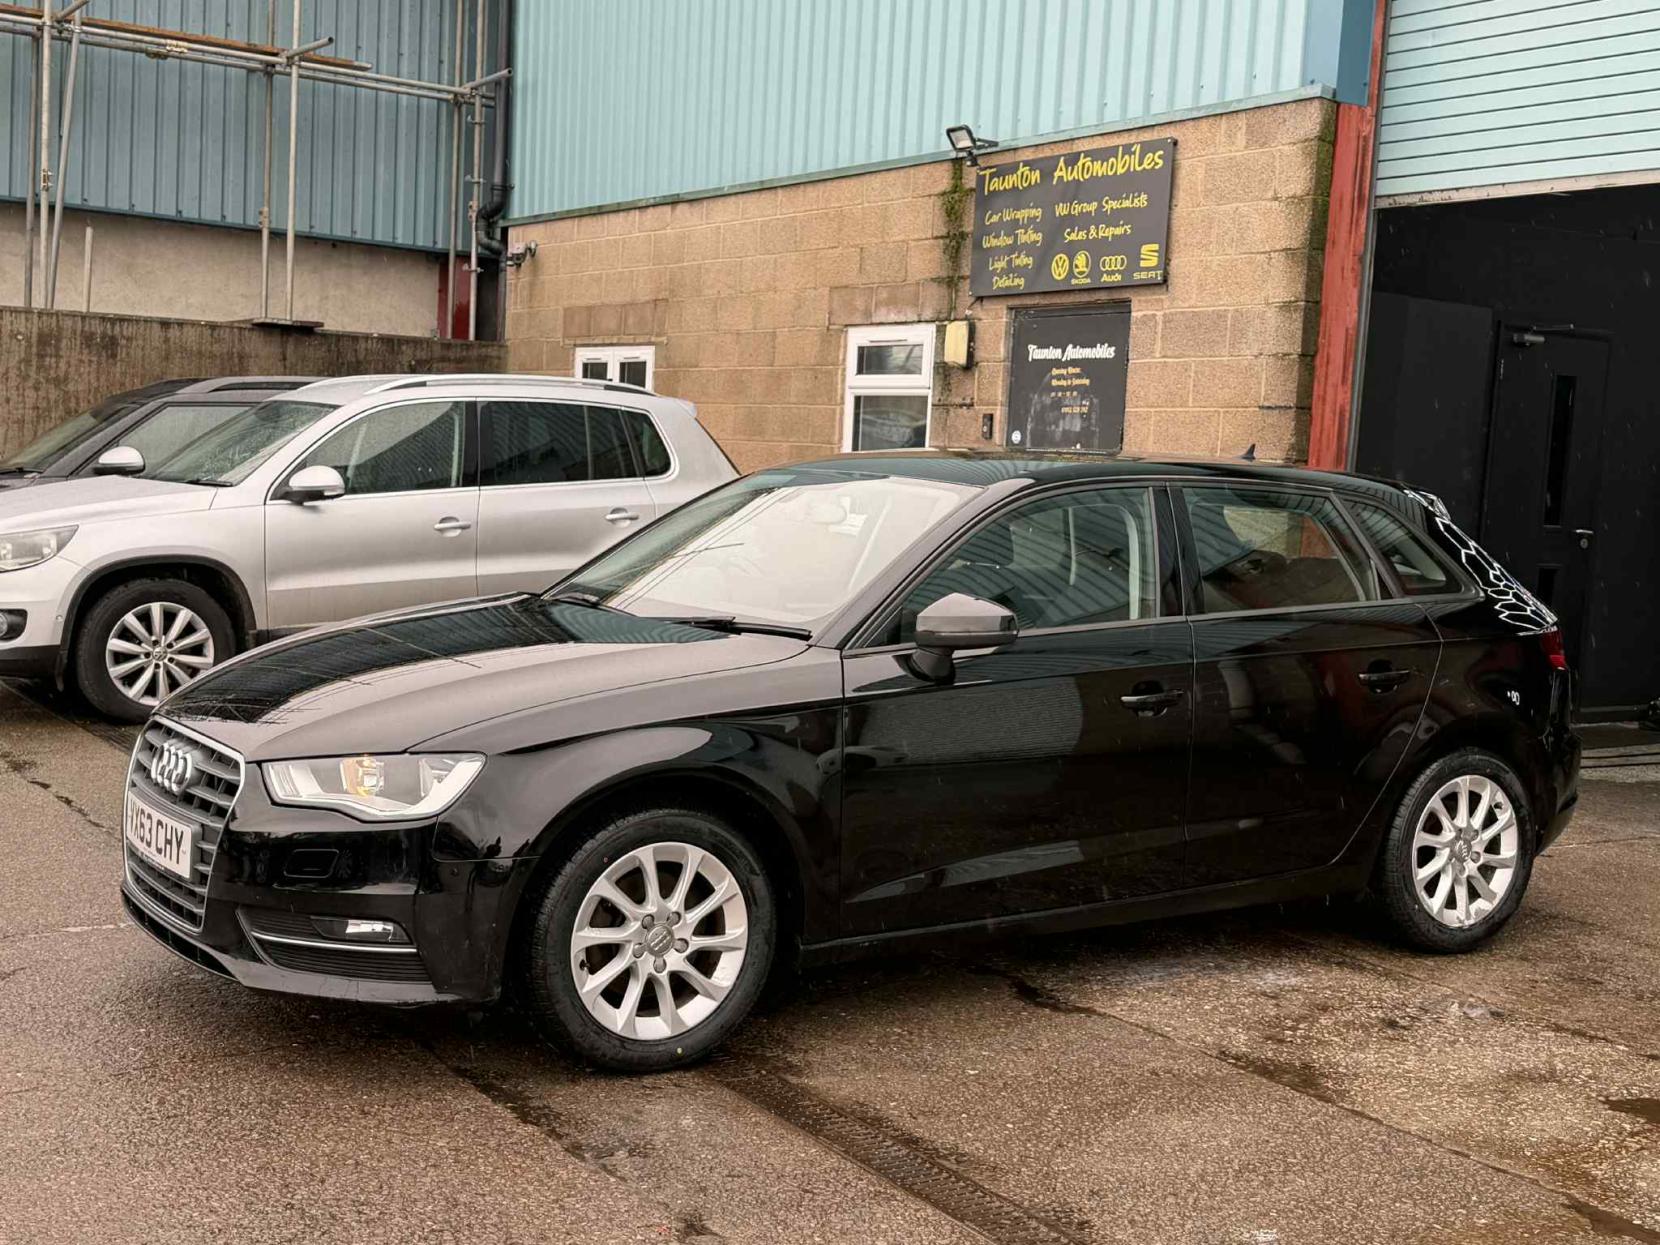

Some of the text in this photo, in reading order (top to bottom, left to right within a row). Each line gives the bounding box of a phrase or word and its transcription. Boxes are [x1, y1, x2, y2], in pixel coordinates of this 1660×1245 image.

[979, 144, 1164, 196] Taunton Automobiles
[985, 202, 1042, 225] Car Wrapping
[1070, 200, 1098, 216] Group
[1102, 192, 1148, 215] Specialists
[982, 224, 1042, 248] Window Tinting
[1064, 220, 1132, 242] Sales & Repairs
[989, 250, 1033, 273] Light Tinting
[992, 273, 1025, 290] Detailing
[1101, 273, 1122, 282] Audi
[1133, 270, 1163, 280] SEAT
[1027, 342, 1116, 362] Taunton Automobiles
[155, 819, 184, 865] CHY
